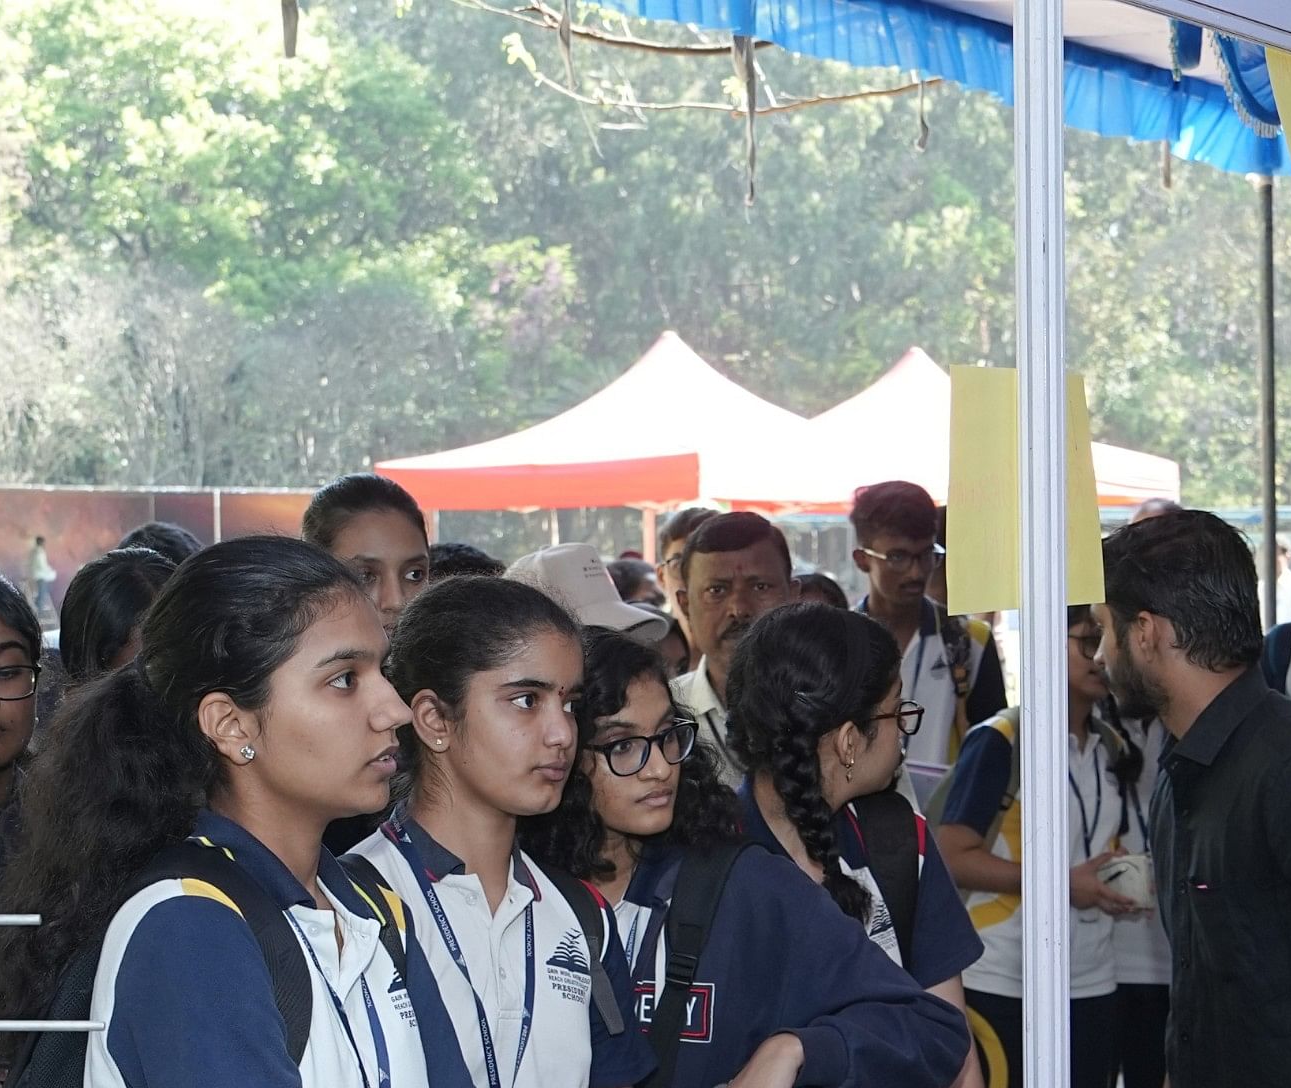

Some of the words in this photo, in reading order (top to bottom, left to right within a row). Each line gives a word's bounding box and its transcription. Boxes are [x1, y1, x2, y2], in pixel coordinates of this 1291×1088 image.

[427, 889, 443, 916] SCHOOL
[435, 914, 457, 952] PRESIDENCY
[480, 1017, 492, 1050] SCHOOL
[485, 1046, 497, 1085] PRESIDENCY
